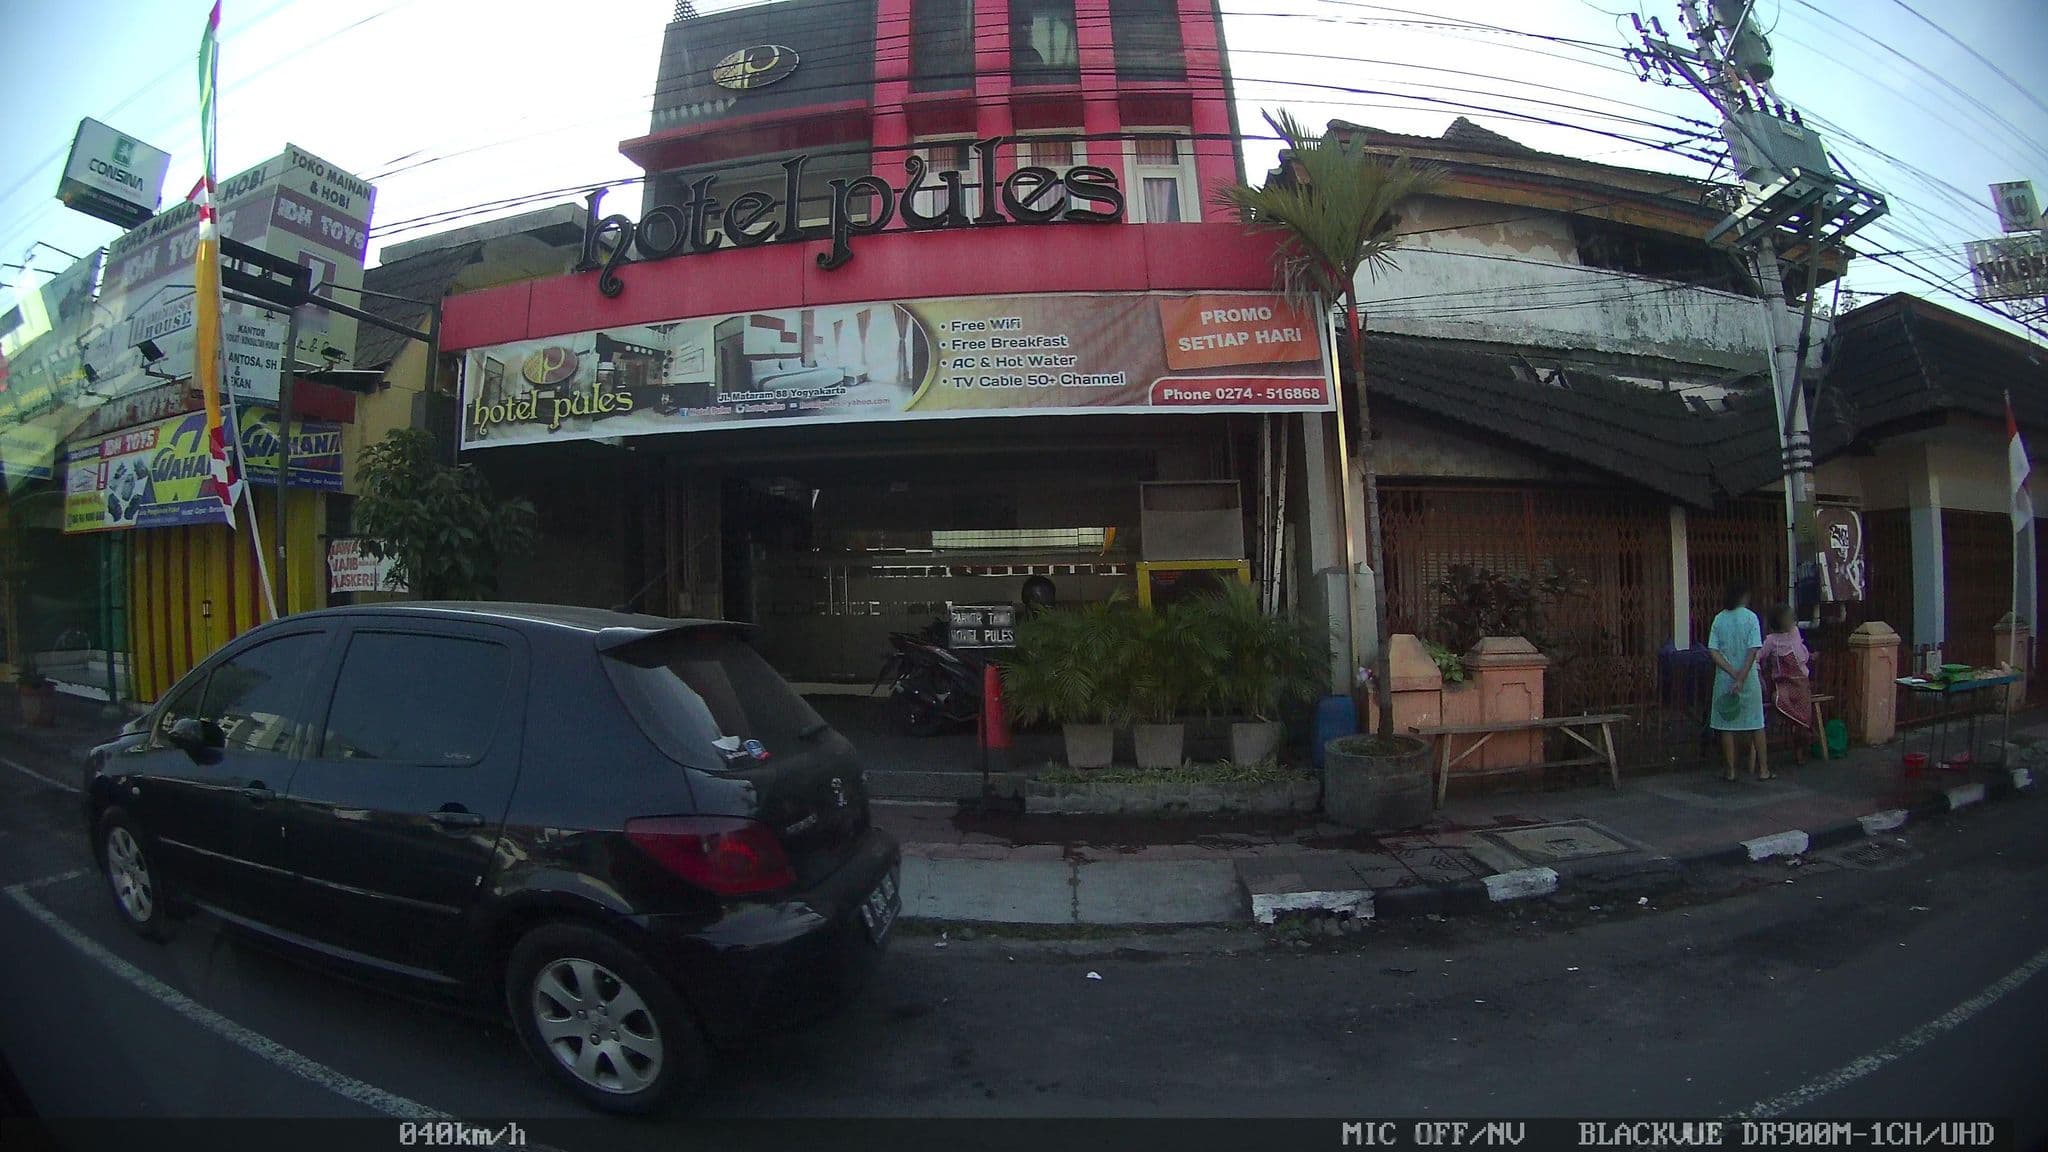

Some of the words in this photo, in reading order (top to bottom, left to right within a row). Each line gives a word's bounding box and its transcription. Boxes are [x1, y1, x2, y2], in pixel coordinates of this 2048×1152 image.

[88, 158, 144, 191] CONSINA
[291, 151, 324, 177] TOKO
[327, 169, 371, 201] MAINAN
[224, 166, 268, 202] HOBI
[310, 181, 318, 194] &
[322, 185, 350, 209] HOBI
[320, 215, 366, 250] TOYS
[1200, 307, 1272, 325] PROMO
[146, 311, 192, 339] HOUSE
[238, 325, 266, 337] KANTOR
[951, 320, 985, 332] Free
[991, 318, 1021, 330] Wifi
[952, 340, 986, 350] Free
[991, 336, 1067, 349] Breakfast
[1178, 332, 1249, 352] SETIAP
[1255, 328, 1302, 344] HARI
[265, 359, 278, 370] SH
[952, 358, 975, 369] AC
[980, 358, 990, 368] &
[996, 357, 1023, 368] Hot
[1028, 355, 1076, 367] Water
[953, 377, 974, 388] TV
[979, 376, 1022, 387] Cable
[1028, 375, 1056, 386] 50+
[1061, 373, 1124, 386] Channel
[718, 393, 730, 402] Jl.
[732, 390, 774, 401] Mataram
[775, 389, 788, 398] 88
[790, 386, 846, 398] Yogyakarta
[1163, 389, 1212, 400] Phone
[1215, 388, 1253, 400] 0274
[1266, 388, 1320, 400] 516868
[473, 389, 538, 435] hotel
[549, 382, 634, 430] pules
[984, 629, 1014, 642] PULES
